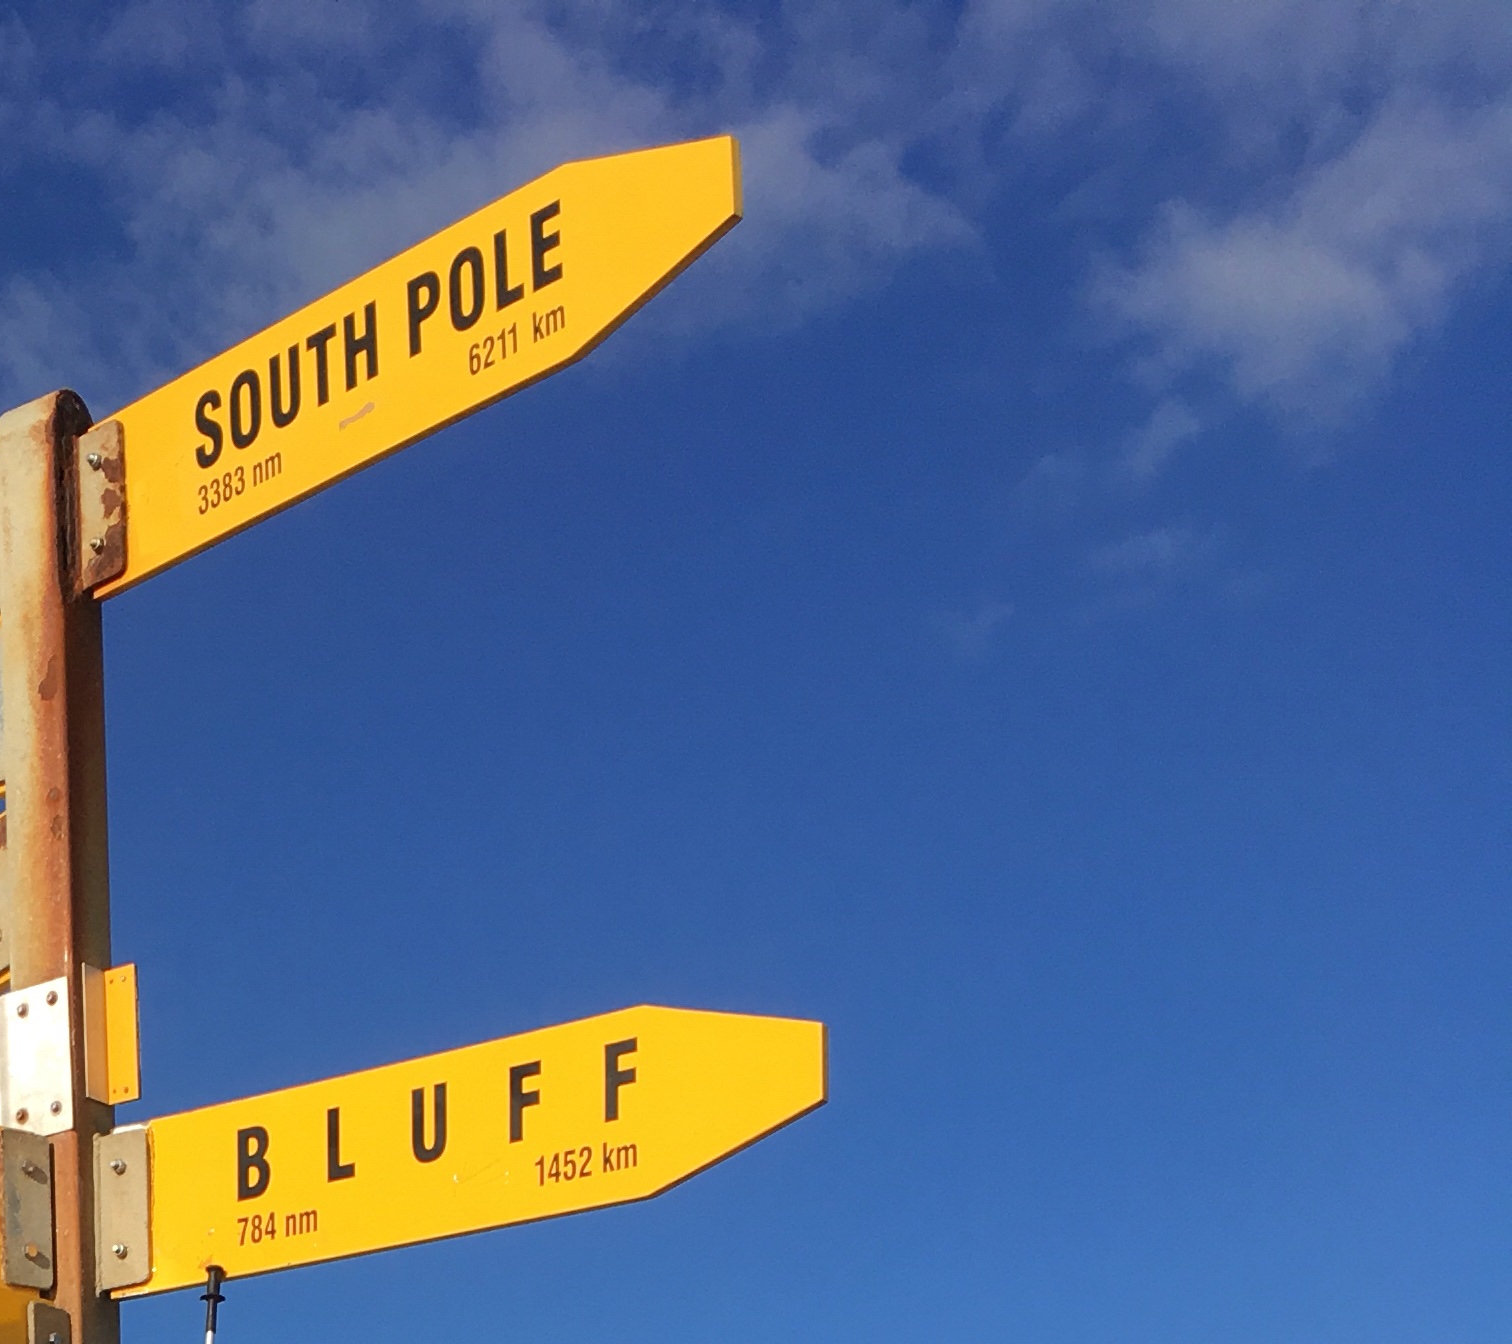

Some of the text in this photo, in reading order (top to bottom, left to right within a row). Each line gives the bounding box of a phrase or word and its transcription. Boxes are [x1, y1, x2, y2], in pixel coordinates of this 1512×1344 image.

[194, 199, 564, 469] SOUTH POLE
[467, 302, 567, 377] 6211 km
[197, 450, 284, 516] 3383 nm
[235, 1036, 639, 1203] BLUFF
[533, 1141, 639, 1189] 1452 km
[236, 1207, 319, 1248] 784 nm
